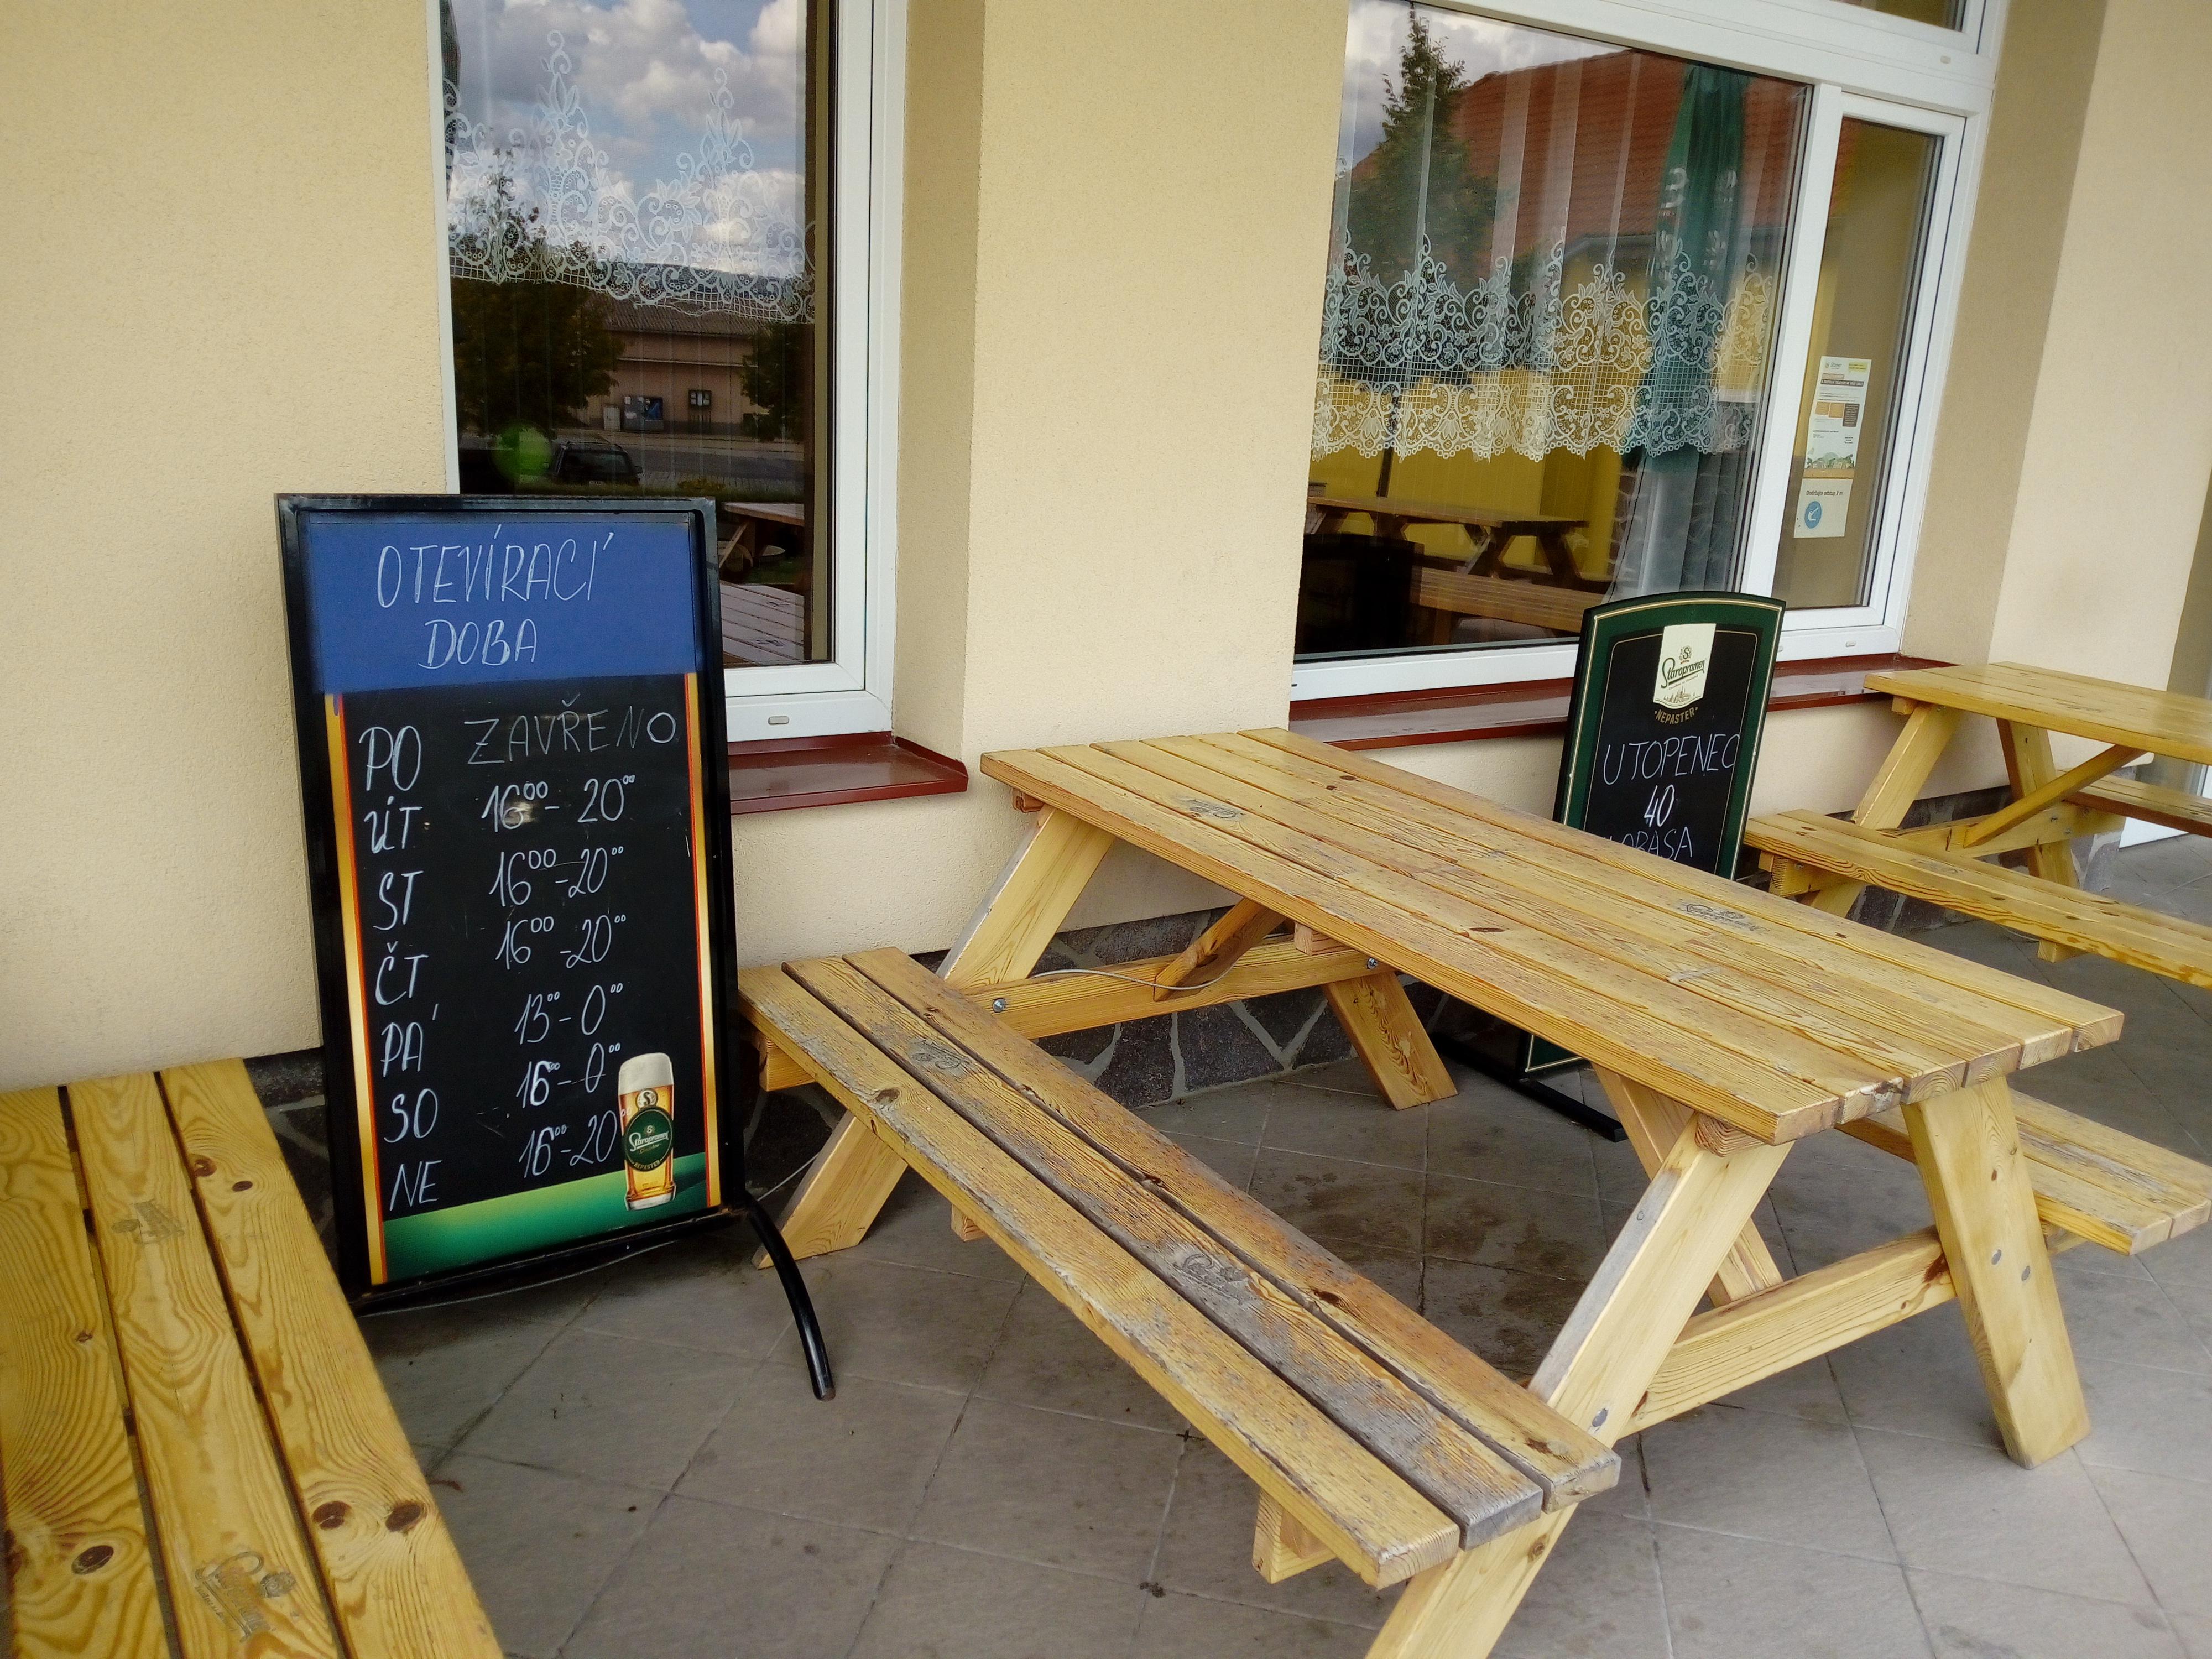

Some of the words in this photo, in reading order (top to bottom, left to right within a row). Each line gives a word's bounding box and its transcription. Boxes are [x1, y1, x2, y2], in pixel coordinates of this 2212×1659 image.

[376, 523, 614, 608] OTEVÍRACÍ
[418, 618, 537, 669] DOBA
[1661, 657, 1705, 689] Staropramen
[358, 724, 422, 791] PO
[463, 693, 676, 765] ZAVŘENO
[1655, 707, 1695, 725] NEPASTER
[1603, 733, 1741, 786] UTOPENEC
[1644, 784, 1676, 828] 40
[1604, 826, 1693, 860] BASA
[372, 870, 424, 931] ST
[374, 940, 429, 1005] ČT
[380, 1003, 439, 1078] PÁ
[383, 1087, 439, 1144] SO
[389, 1159, 442, 1212] NE
